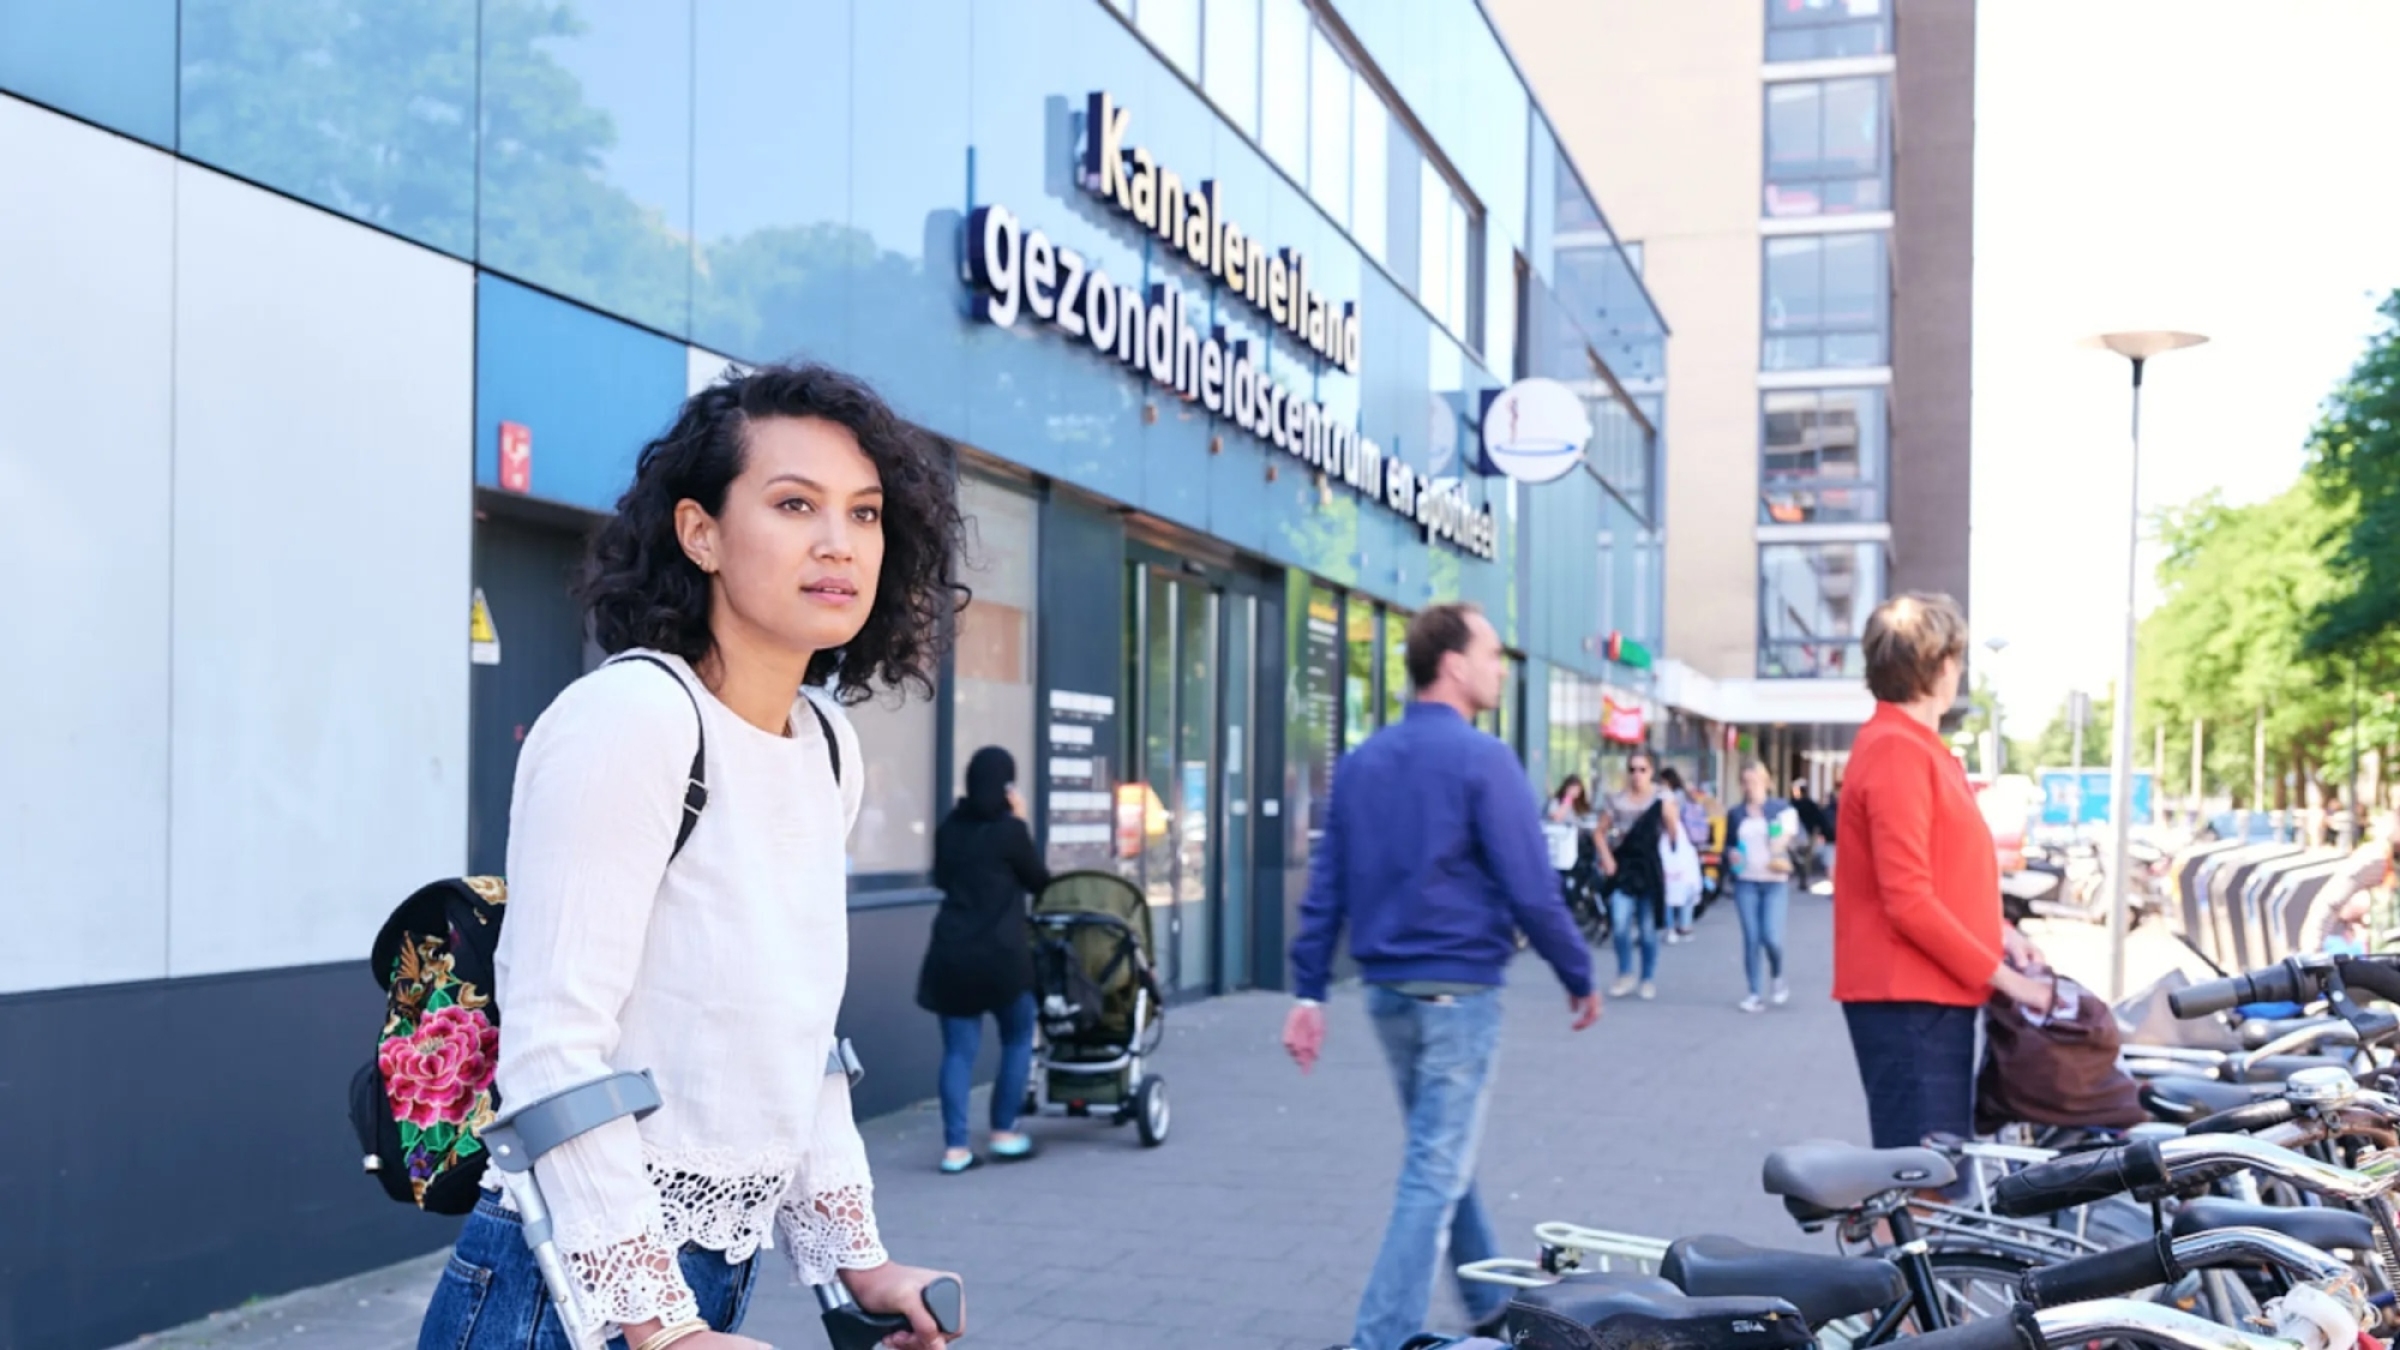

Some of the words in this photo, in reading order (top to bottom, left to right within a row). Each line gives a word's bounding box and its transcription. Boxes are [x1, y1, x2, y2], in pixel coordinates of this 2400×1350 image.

[980, 203, 1381, 500] gezondheidscentrum
[1385, 455, 1415, 518] en
[1096, 89, 1359, 377] Kanaleneiland
